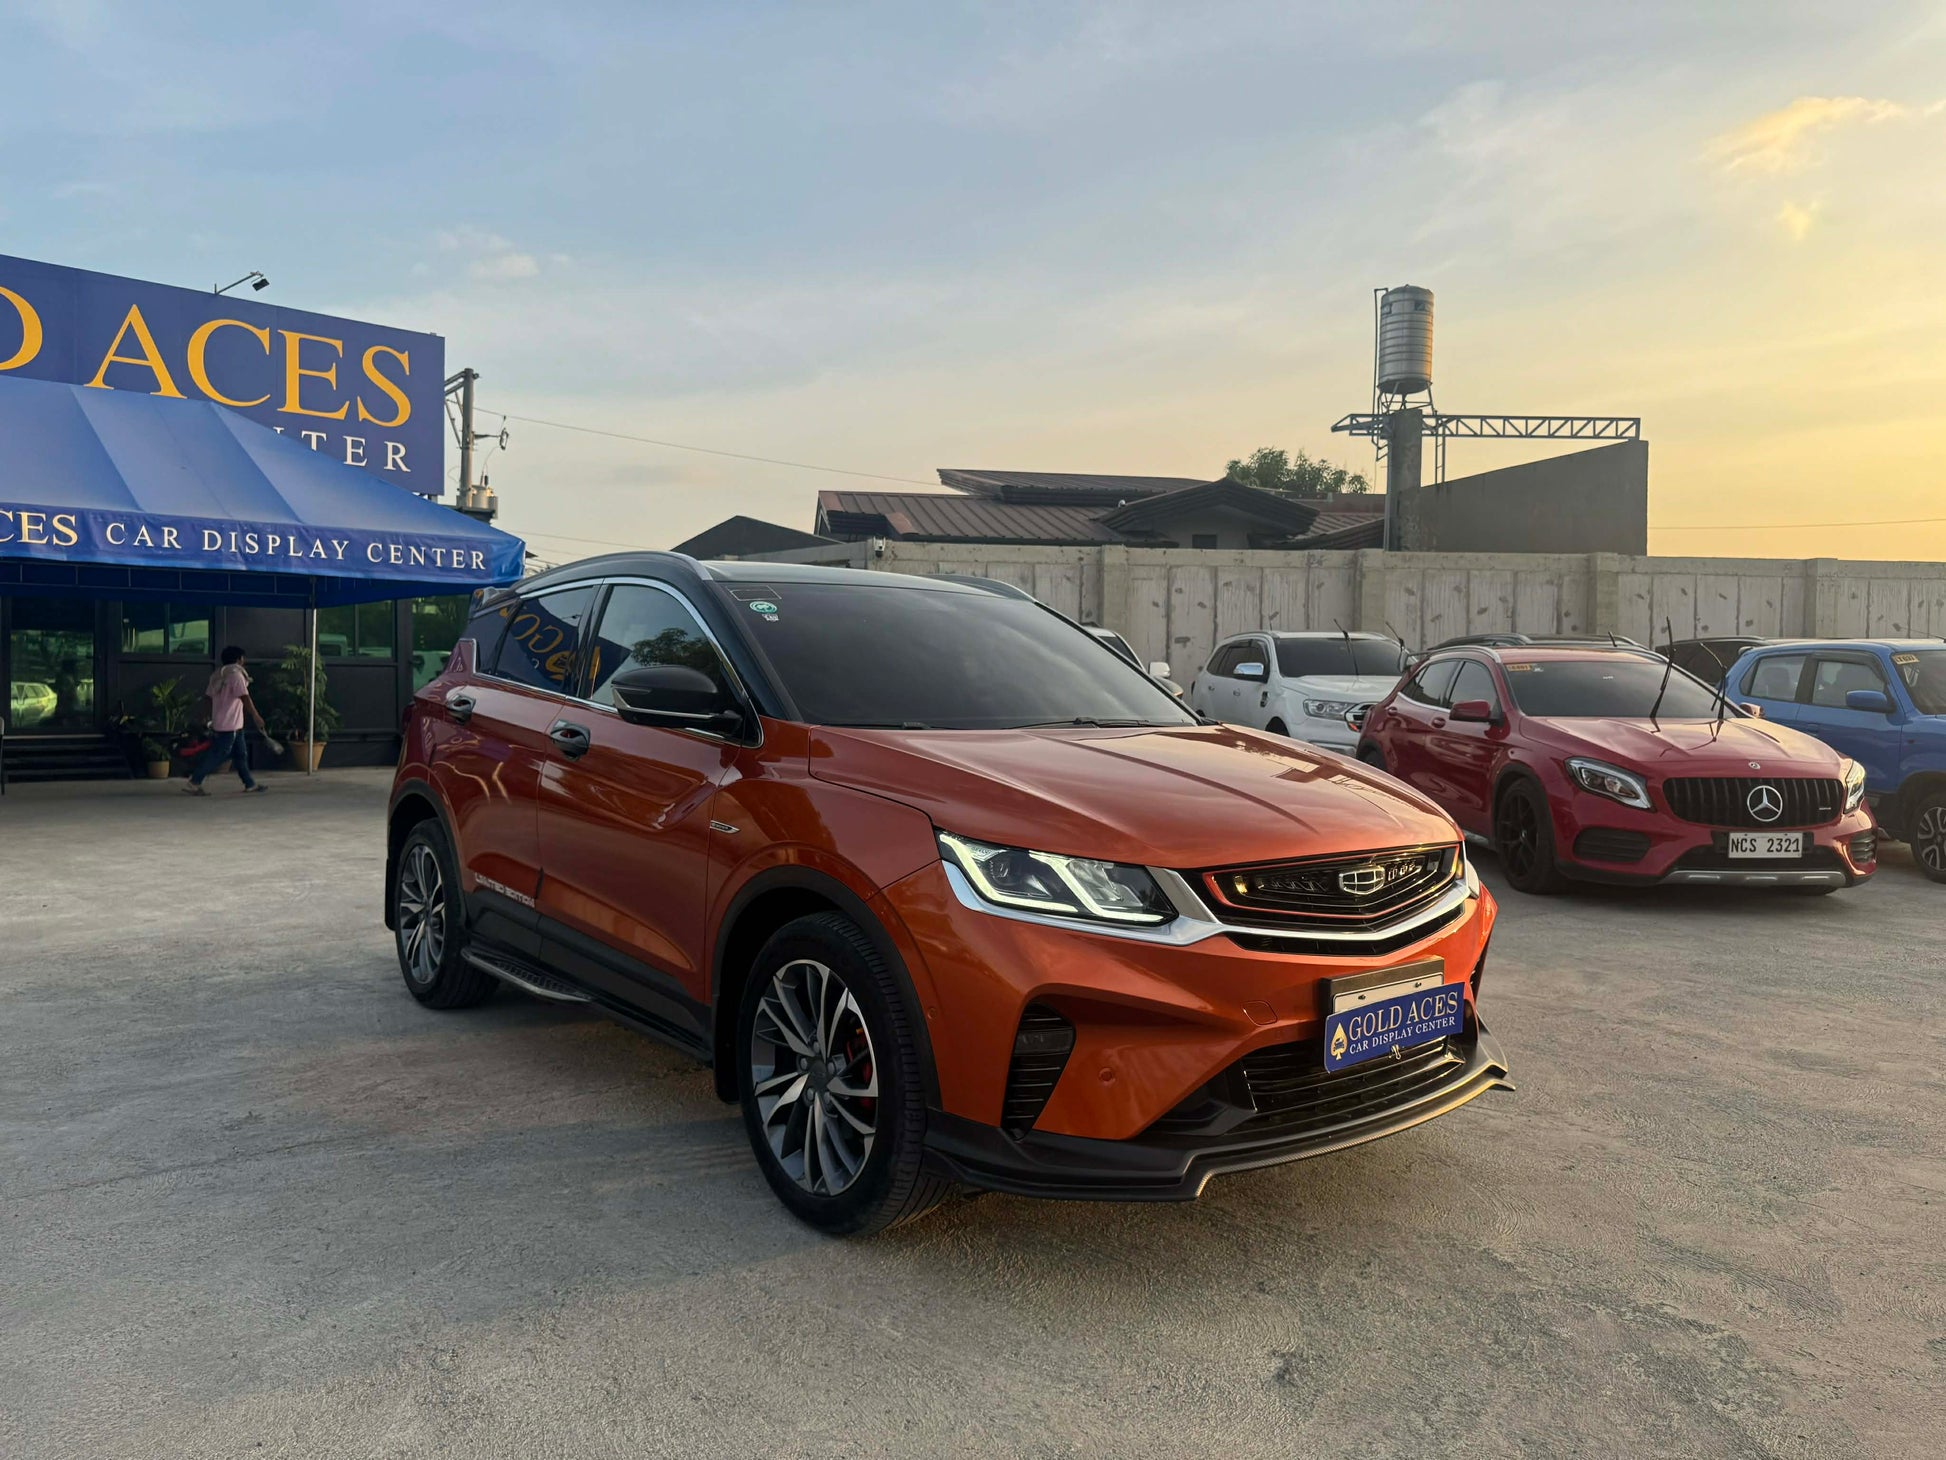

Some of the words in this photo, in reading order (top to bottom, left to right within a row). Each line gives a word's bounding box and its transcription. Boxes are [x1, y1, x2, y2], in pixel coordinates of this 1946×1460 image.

[83, 303, 411, 428] ACES
[272, 426, 412, 473] TER
[106, 522, 182, 550] CAR
[202, 529, 350, 560] DISPLAY
[366, 542, 487, 570] CENTER
[1730, 837, 1757, 853] NCS
[1766, 837, 1801, 853] 2321
[1348, 1004, 1403, 1041] GOLD
[1405, 991, 1459, 1025] ACES
[1349, 1039, 1369, 1055] CAR
[1372, 1026, 1413, 1048] DISPLAY
[1415, 1016, 1456, 1034] CENTER
